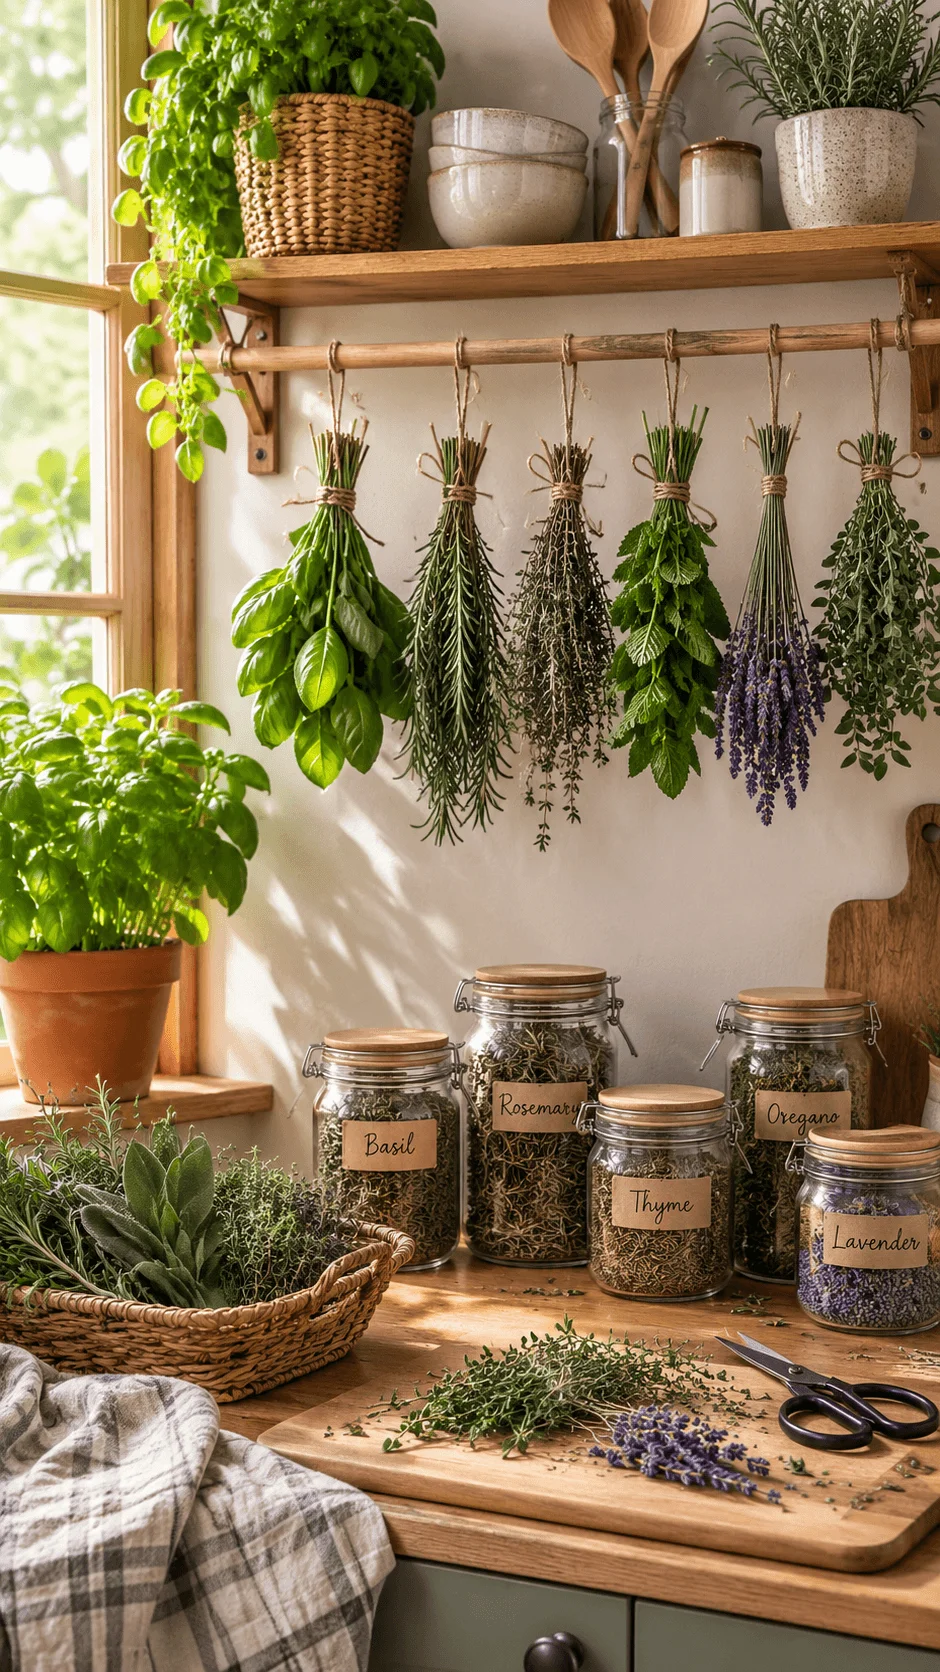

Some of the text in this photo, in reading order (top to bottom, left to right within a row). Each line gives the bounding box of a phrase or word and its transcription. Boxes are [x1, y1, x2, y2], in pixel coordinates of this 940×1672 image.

[499, 1093, 582, 1125] Rosemary
[767, 1102, 840, 1136] Oregano
[364, 1132, 415, 1157] Basil
[629, 1189, 695, 1225] Thyme
[832, 1224, 921, 1251] Lavender
